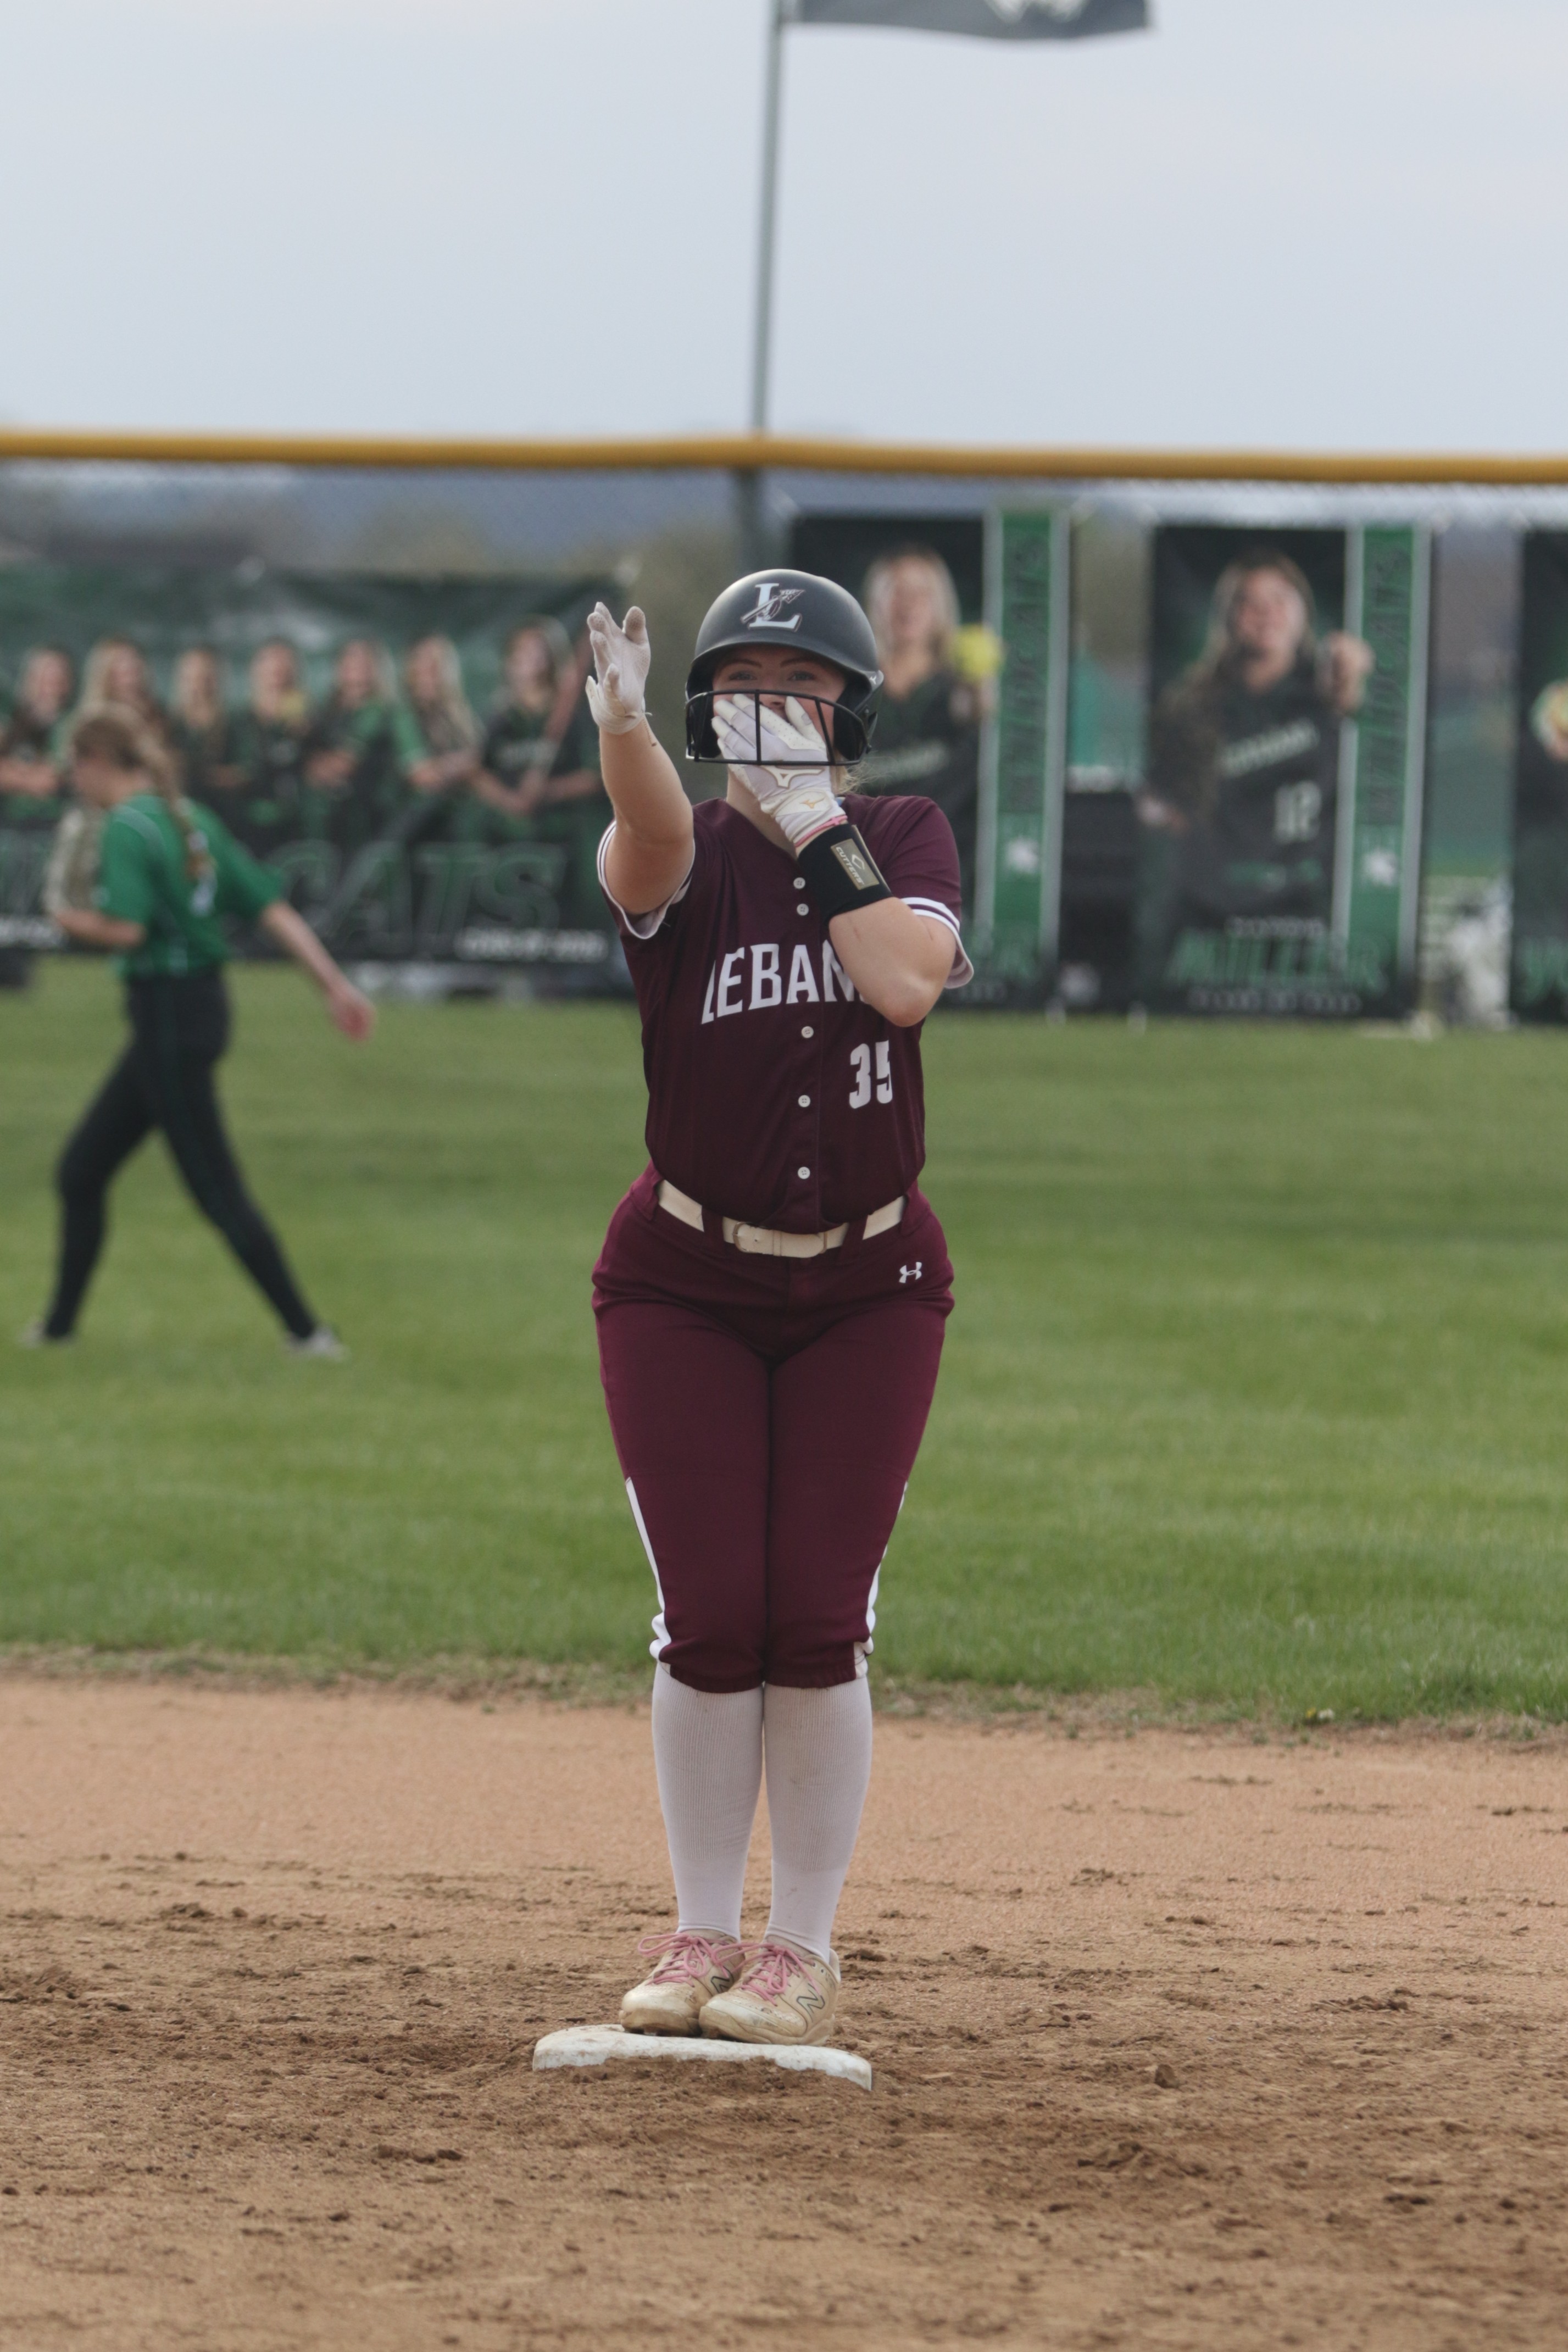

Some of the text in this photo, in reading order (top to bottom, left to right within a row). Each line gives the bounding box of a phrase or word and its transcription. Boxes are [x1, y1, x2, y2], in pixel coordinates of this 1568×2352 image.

[748, 582, 802, 632] L
[835, 846, 865, 886] CUTTERS
[701, 939, 864, 1025] LEBAN
[849, 1039, 893, 1109] 35
